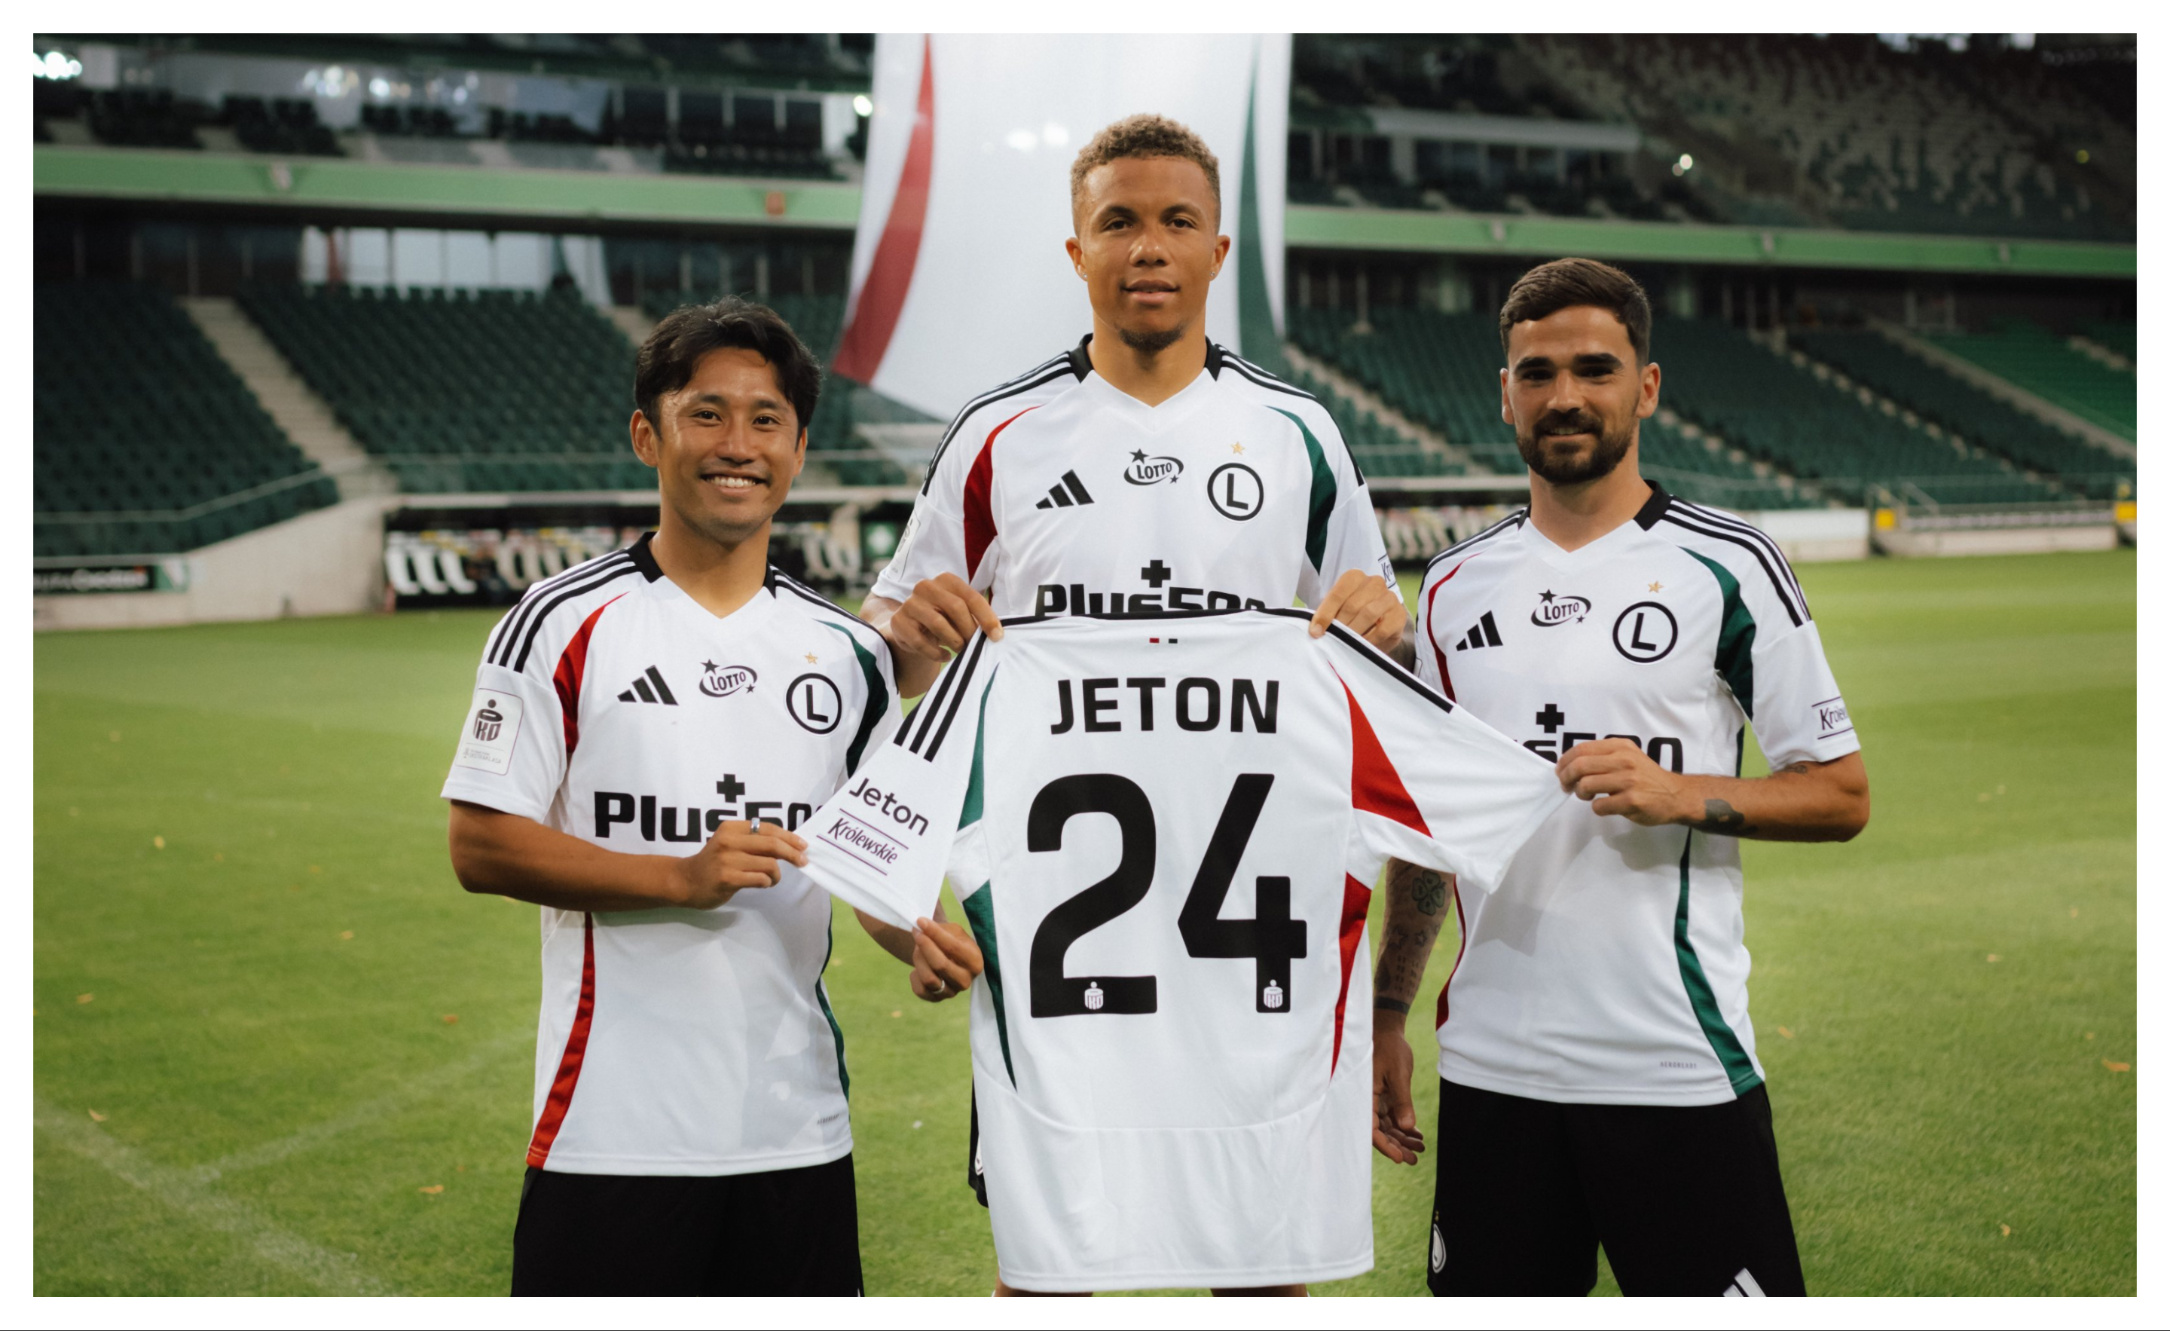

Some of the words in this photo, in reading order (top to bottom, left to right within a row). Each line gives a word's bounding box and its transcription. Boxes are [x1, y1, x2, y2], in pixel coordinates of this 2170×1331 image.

[1136, 462, 1172, 480] LOTTO
[1226, 472, 1249, 511] L
[1544, 602, 1579, 620] LOTTO
[1631, 612, 1657, 652] L
[709, 671, 746, 692] LOTTO
[805, 684, 829, 724] L
[1050, 677, 1279, 735] JETON
[848, 777, 929, 836] Jeton
[827, 817, 898, 864] Królewskie
[1027, 773, 1307, 1018] 24
